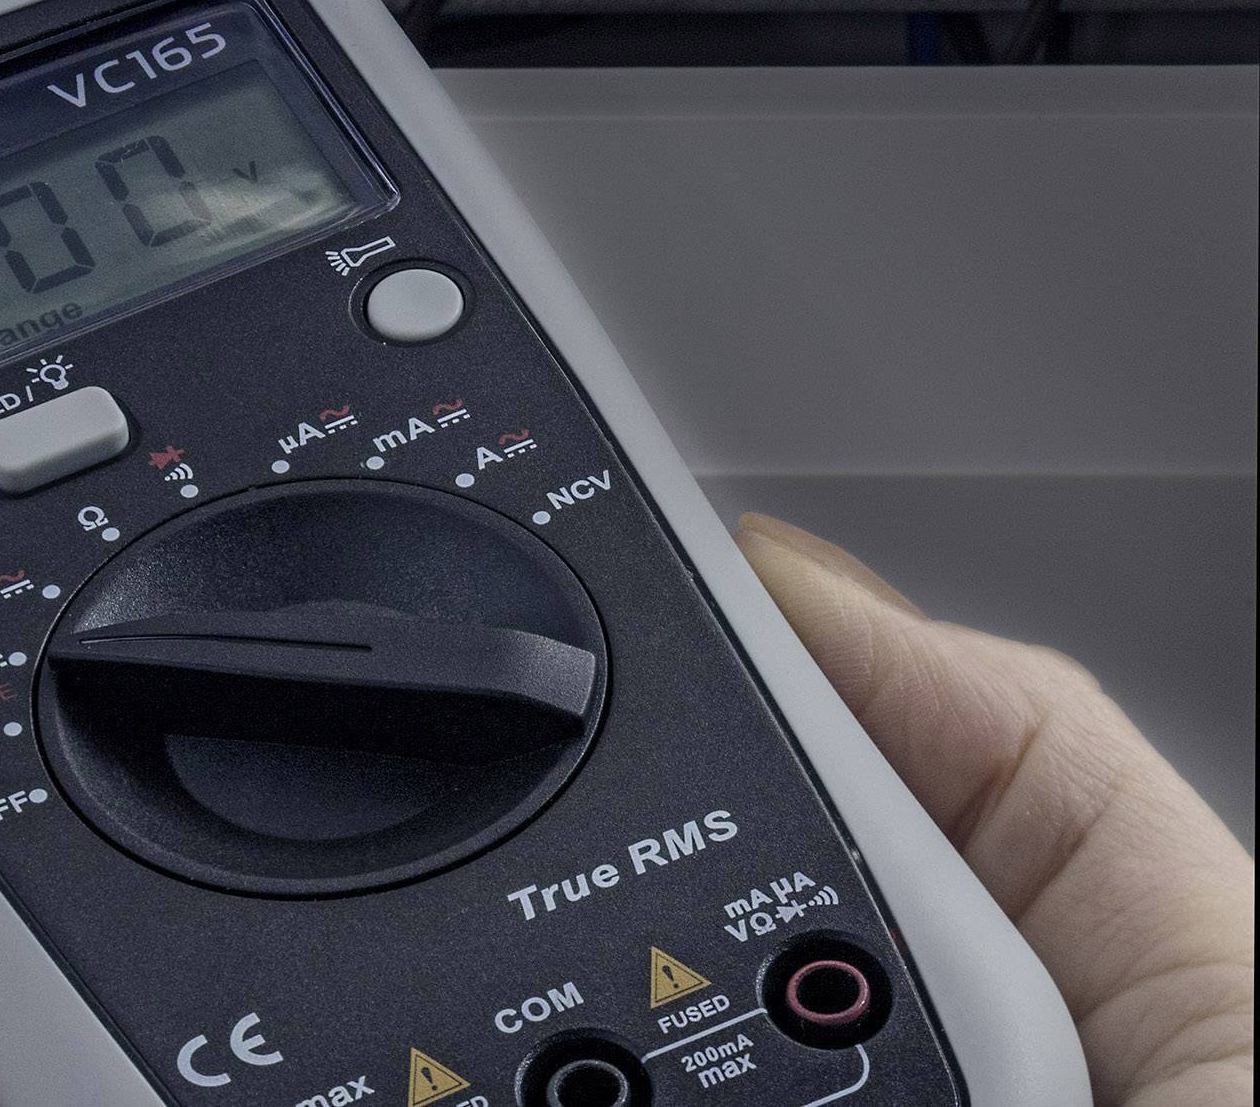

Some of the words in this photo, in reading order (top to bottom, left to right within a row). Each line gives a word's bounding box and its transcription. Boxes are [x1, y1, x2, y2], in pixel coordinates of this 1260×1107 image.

[47, 22, 228, 109] VC165
[372, 416, 436, 452] mA
[546, 469, 612, 510] NCV
[507, 863, 620, 921] True
[627, 809, 738, 875] RMS
[494, 981, 585, 1034] COM
[658, 994, 730, 1034] FUSED
[177, 1012, 283, 1087] CE
[681, 1034, 754, 1072] 200mA
[698, 1053, 757, 1089] max
